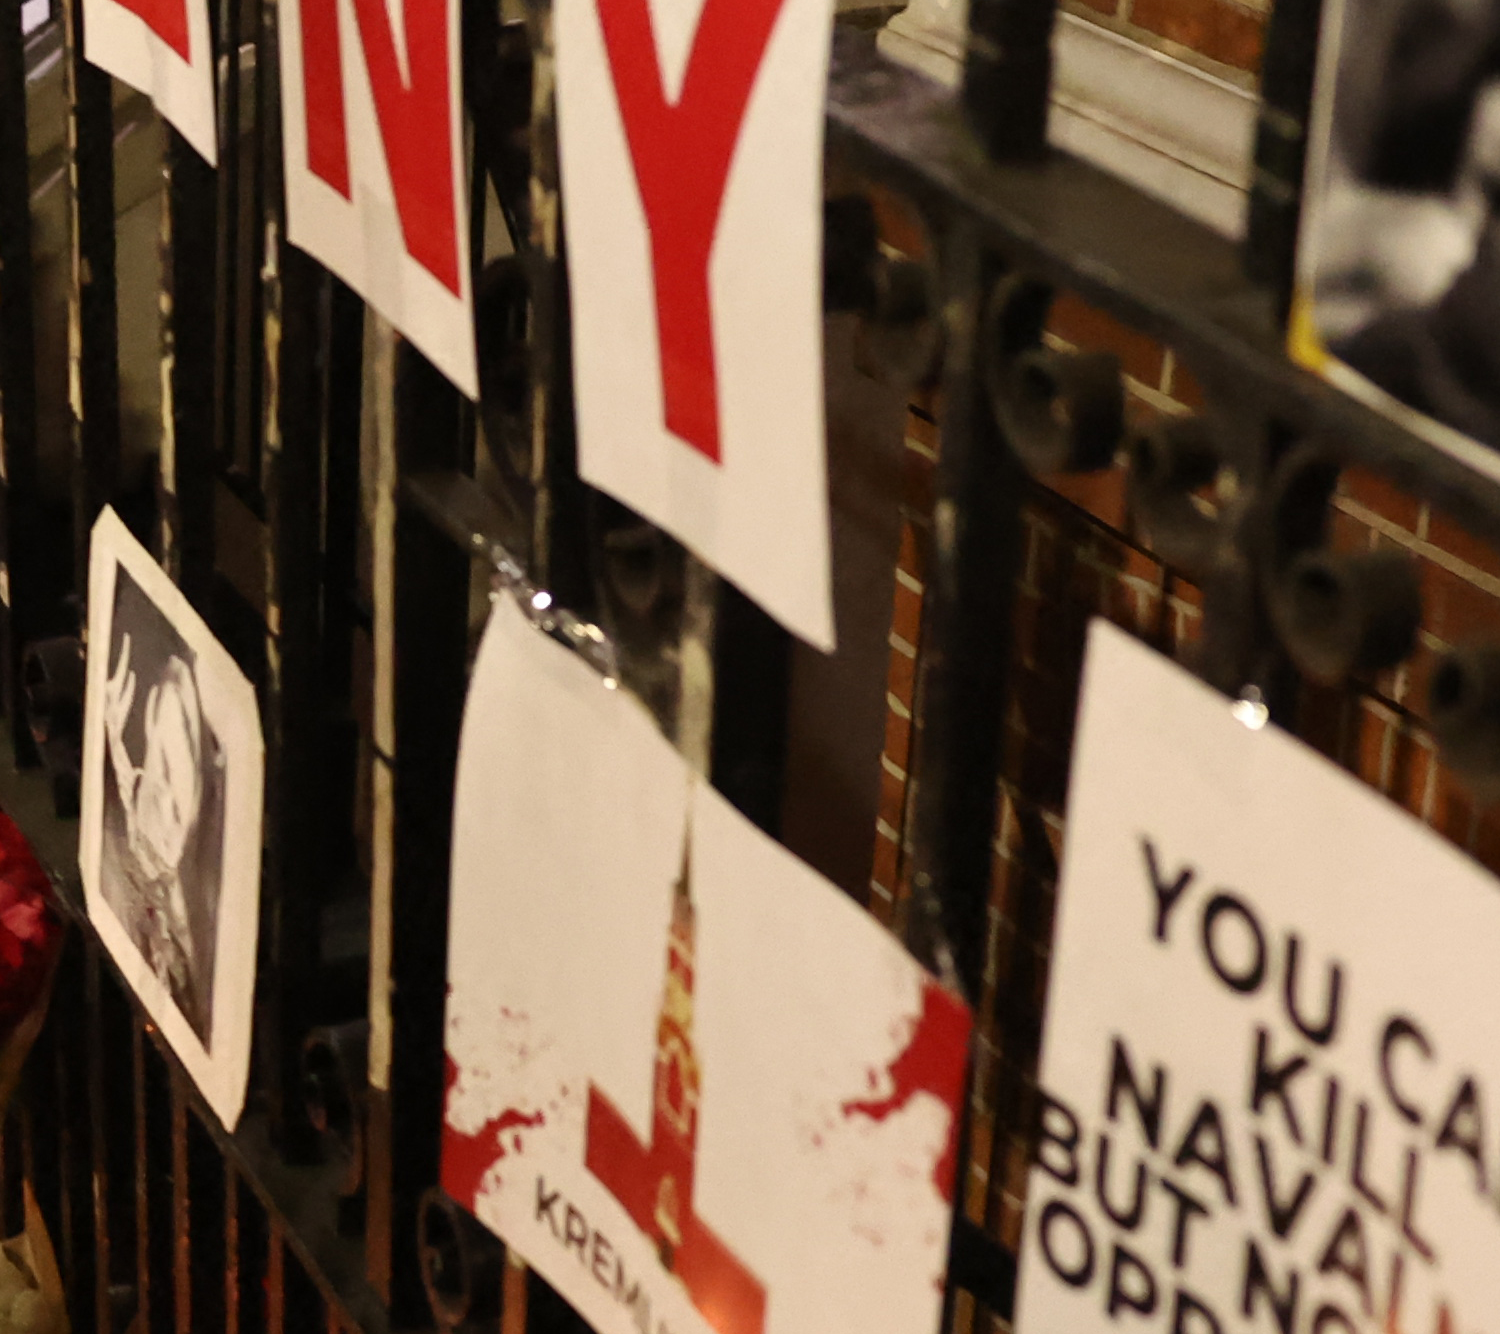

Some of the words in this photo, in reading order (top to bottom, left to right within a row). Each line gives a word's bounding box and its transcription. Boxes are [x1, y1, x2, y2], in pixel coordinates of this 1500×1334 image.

[1138, 831, 1343, 1047] YOU
[1034, 1087, 1211, 1268] BUT
[1252, 1023, 1437, 1267] KILL
